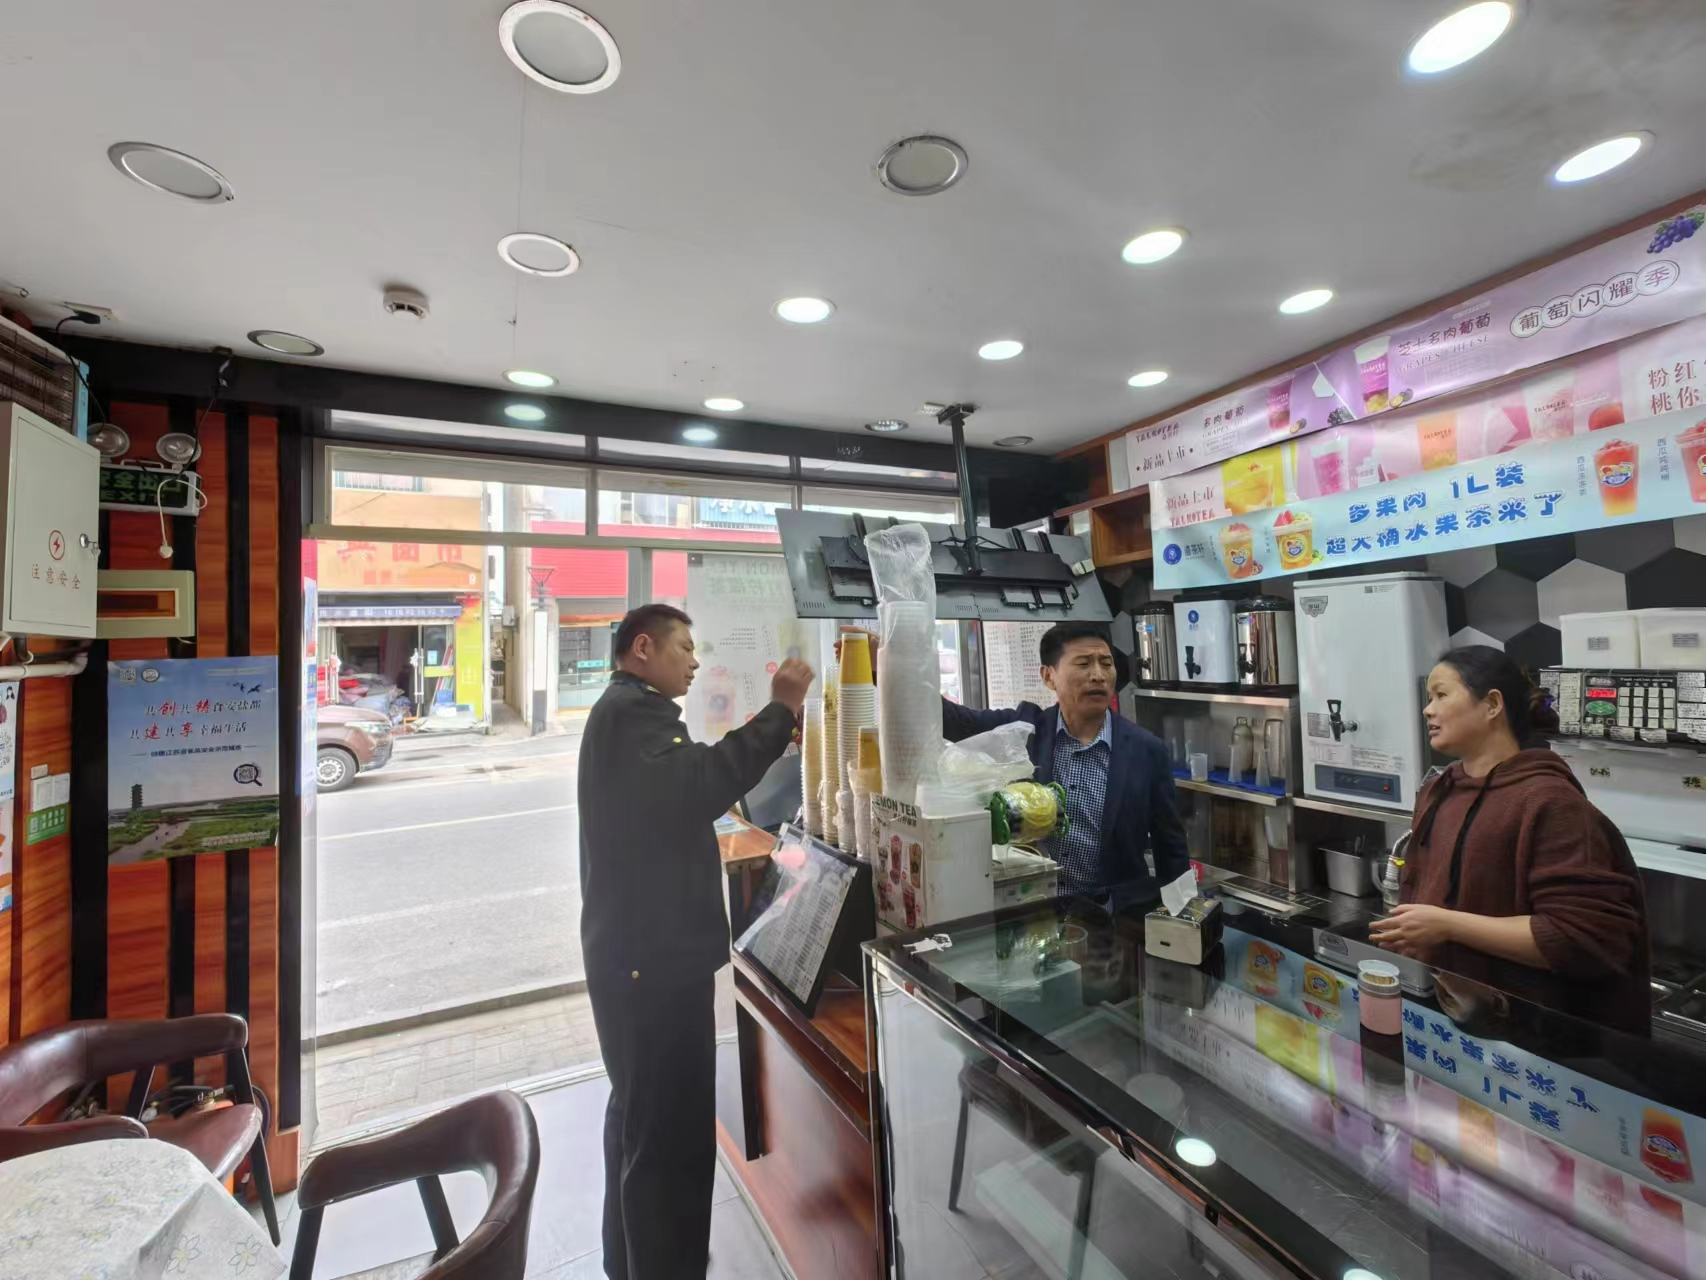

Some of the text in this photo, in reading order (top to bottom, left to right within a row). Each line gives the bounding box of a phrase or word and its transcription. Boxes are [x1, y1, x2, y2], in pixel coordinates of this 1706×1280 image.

[1518, 265, 1671, 332] 葡萄闪耀季
[1398, 312, 1492, 357] 芝士多肉葡萄
[1648, 357, 1706, 390] 粉红
[1325, 490, 1566, 556] 超大桶水果茶来了
[1348, 489, 1428, 524] 多果肉
[32, 563, 81, 590] 注意安全
[899, 802, 917, 818] TEA
